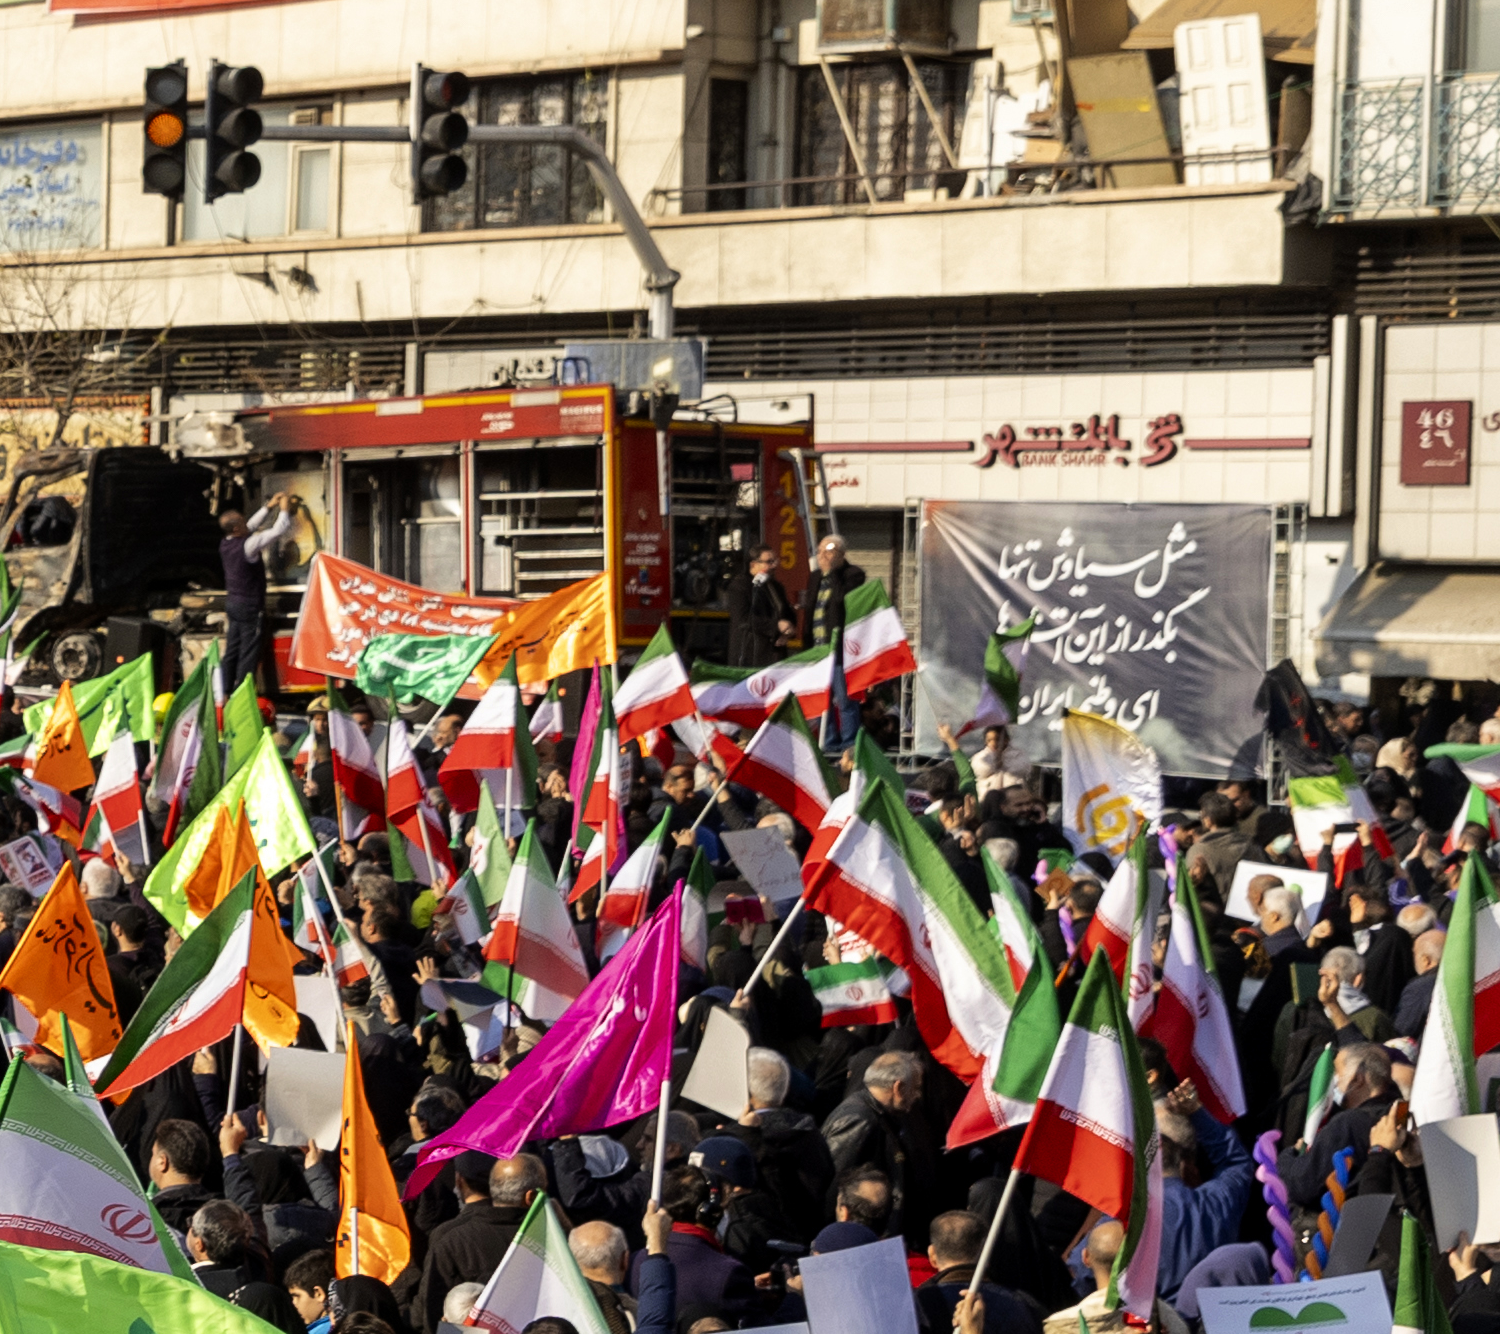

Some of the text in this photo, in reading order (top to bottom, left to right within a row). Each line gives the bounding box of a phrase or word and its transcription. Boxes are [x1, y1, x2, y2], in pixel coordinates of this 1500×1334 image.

[1415, 408, 1455, 429] 46
[972, 415, 1132, 468] بانک شهر
[1021, 452, 1106, 467] BANK SHAHR
[998, 521, 1198, 599] مثل سیاوش تنها
[1106, 615, 1133, 654] از
[1128, 585, 1212, 664] بگذر
[1017, 683, 1075, 731] ایران
[1116, 688, 1161, 731] ای
